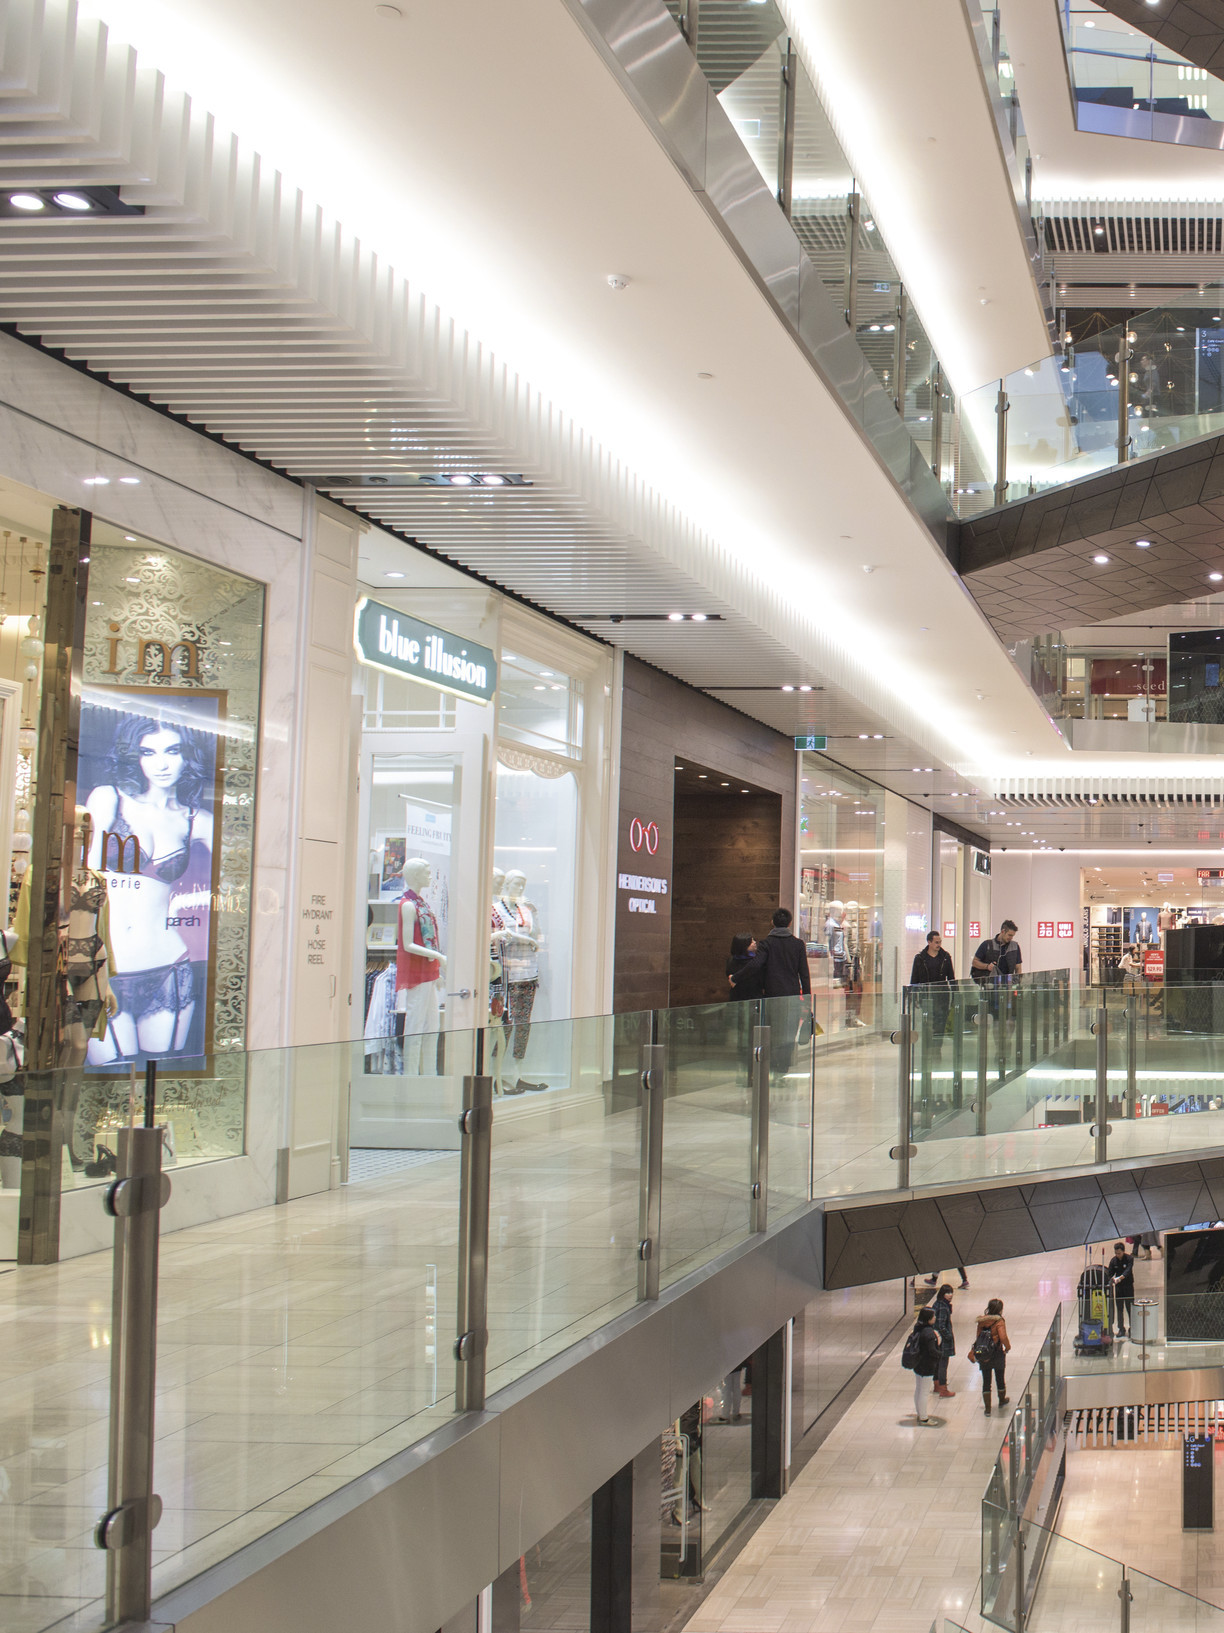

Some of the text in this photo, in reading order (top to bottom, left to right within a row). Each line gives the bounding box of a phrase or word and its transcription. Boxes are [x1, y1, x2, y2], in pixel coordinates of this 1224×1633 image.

[101, 622, 202, 677] im
[379, 614, 487, 688] blue illusion
[1136, 680, 1166, 691] seed
[311, 894, 326, 906] FIRE
[302, 908, 333, 920] HYDRANT
[165, 915, 200, 931] parah
[314, 924, 320, 935] &
[307, 939, 326, 950] HOSE
[307, 954, 325, 965] REEL
